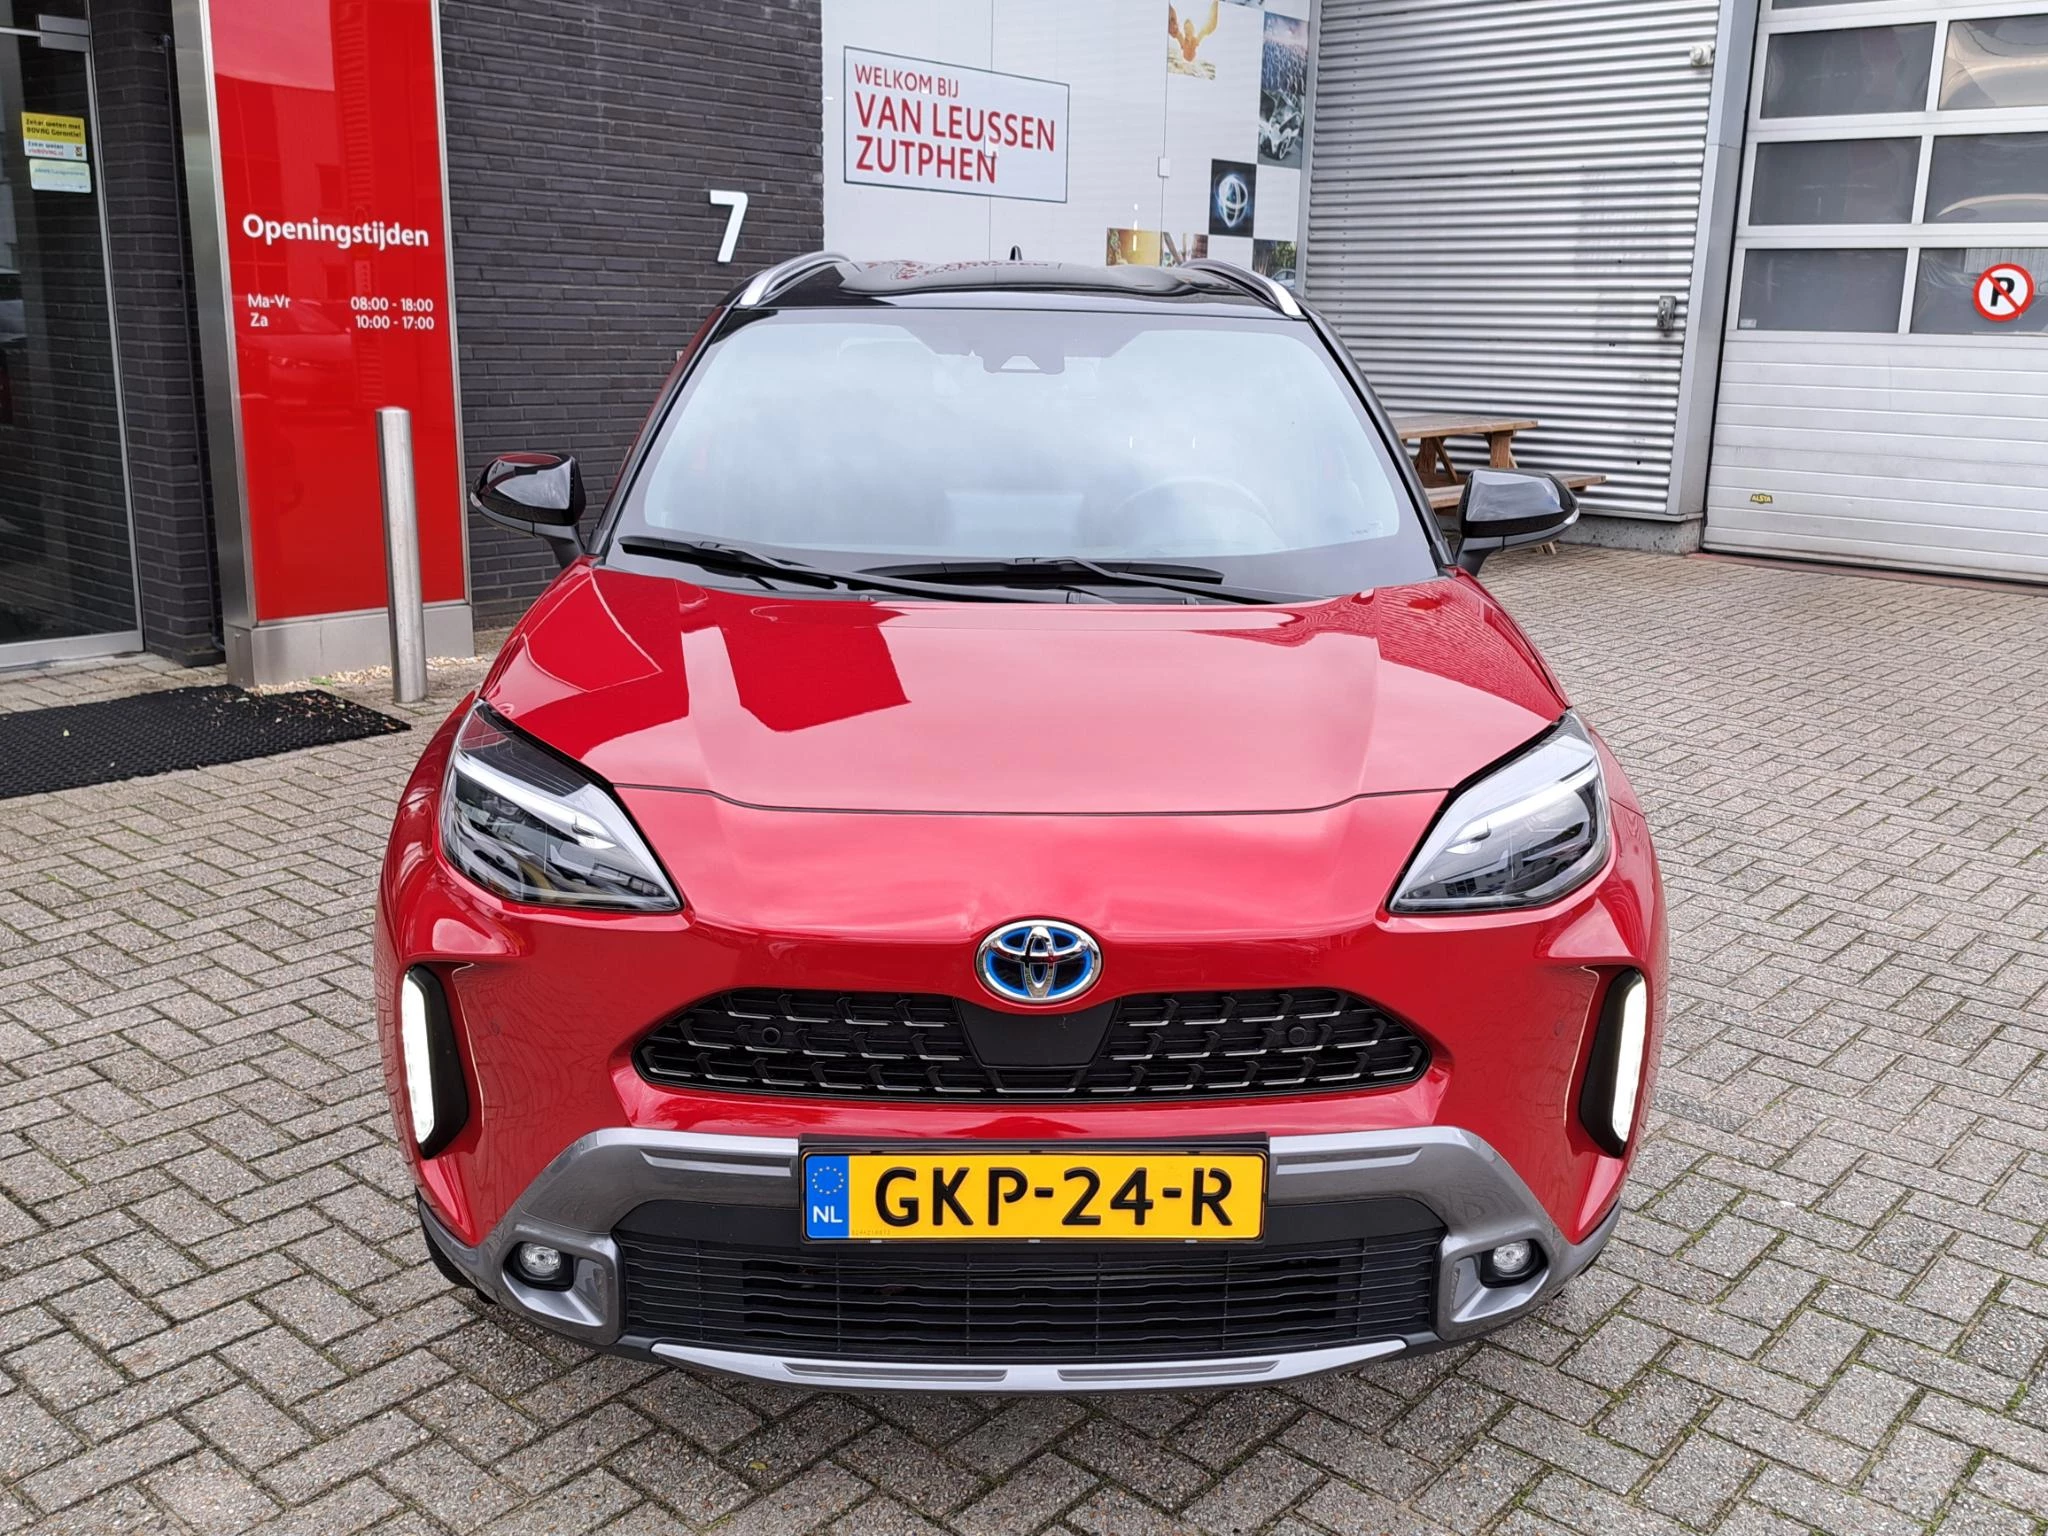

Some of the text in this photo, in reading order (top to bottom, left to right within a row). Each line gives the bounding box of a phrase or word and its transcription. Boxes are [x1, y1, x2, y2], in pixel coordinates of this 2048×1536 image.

[855, 64, 959, 98] WELKOM BIJ
[46, 121, 67, 129] weten
[855, 91, 1055, 152] VAN LEUSSEN
[856, 135, 997, 184] ZUTPHEN
[243, 214, 429, 251] Openingstijden
[710, 189, 749, 262] 7
[247, 293, 291, 309] Ma-Vr
[351, 296, 389, 311] 08:00
[402, 298, 433, 312] 18:00
[1990, 276, 2015, 307] P
[250, 312, 268, 327] Za
[355, 315, 389, 329] 10:00
[402, 316, 434, 330] 17:00
[813, 1205, 843, 1223] NL
[875, 1167, 1233, 1227] GKP-24-R
